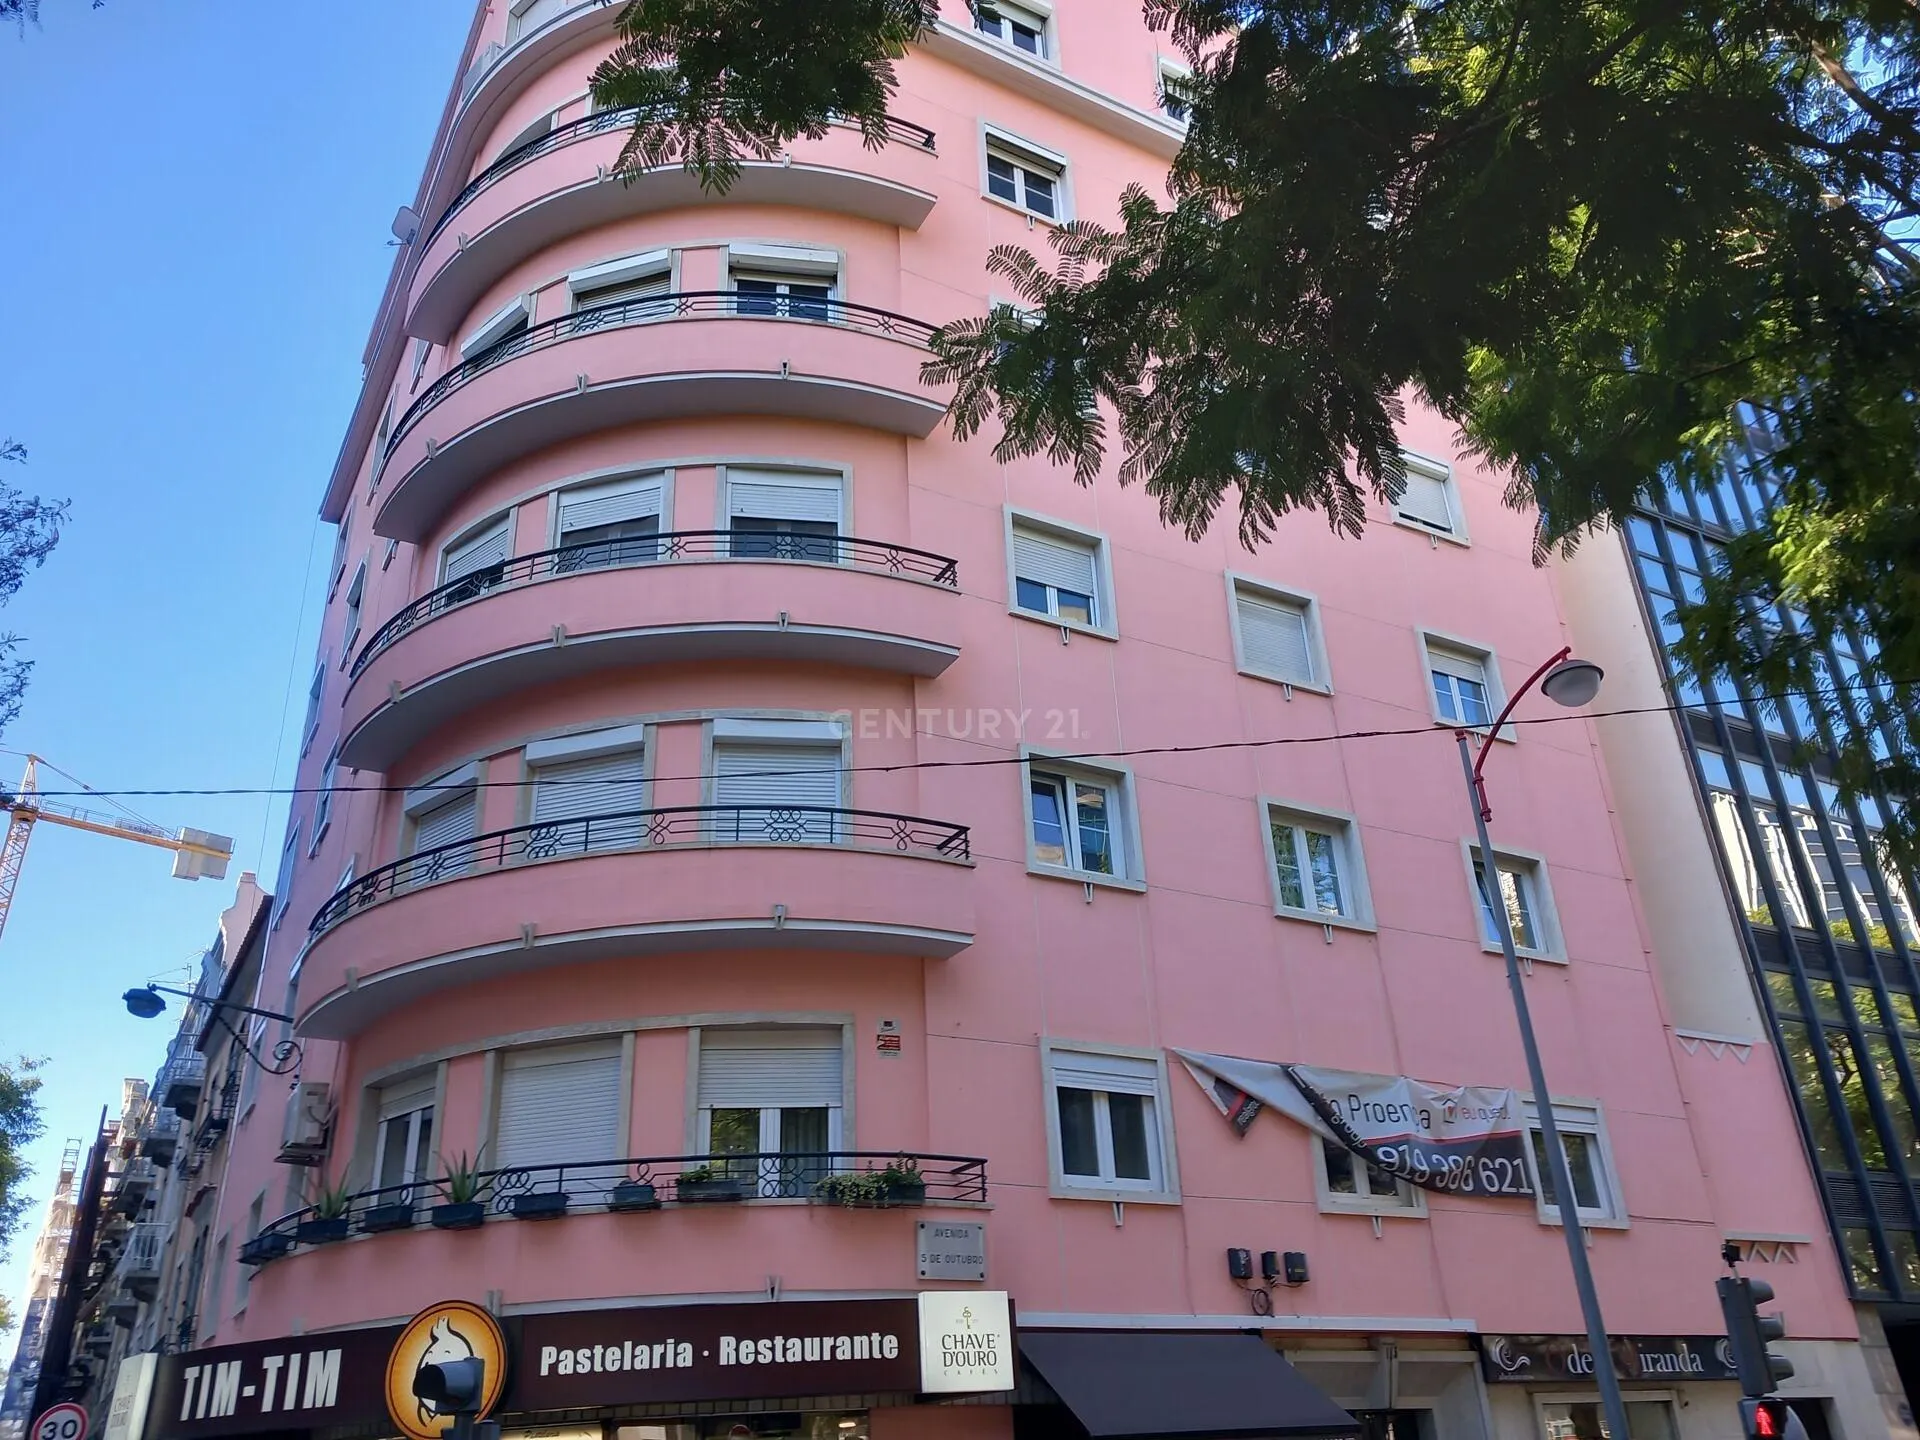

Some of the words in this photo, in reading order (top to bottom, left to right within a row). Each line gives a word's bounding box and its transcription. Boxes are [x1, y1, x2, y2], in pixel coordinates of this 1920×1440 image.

[1348, 1094, 1431, 1130] Proena
[1478, 1156, 1534, 1194] 621
[934, 1228, 969, 1239] AVENIDA
[920, 1253, 928, 1263] 5
[929, 1253, 942, 1264] DE
[944, 1254, 984, 1265] OUTUBRO
[540, 1338, 693, 1376] Pastelaria
[719, 1332, 899, 1366] Restaurante
[941, 1333, 996, 1350] CHAVE
[942, 1350, 997, 1367] D'OURO
[1626, 1341, 1704, 1374] iranda
[180, 1348, 342, 1421] TIM-TIM
[42, 1420, 78, 1440] 30
